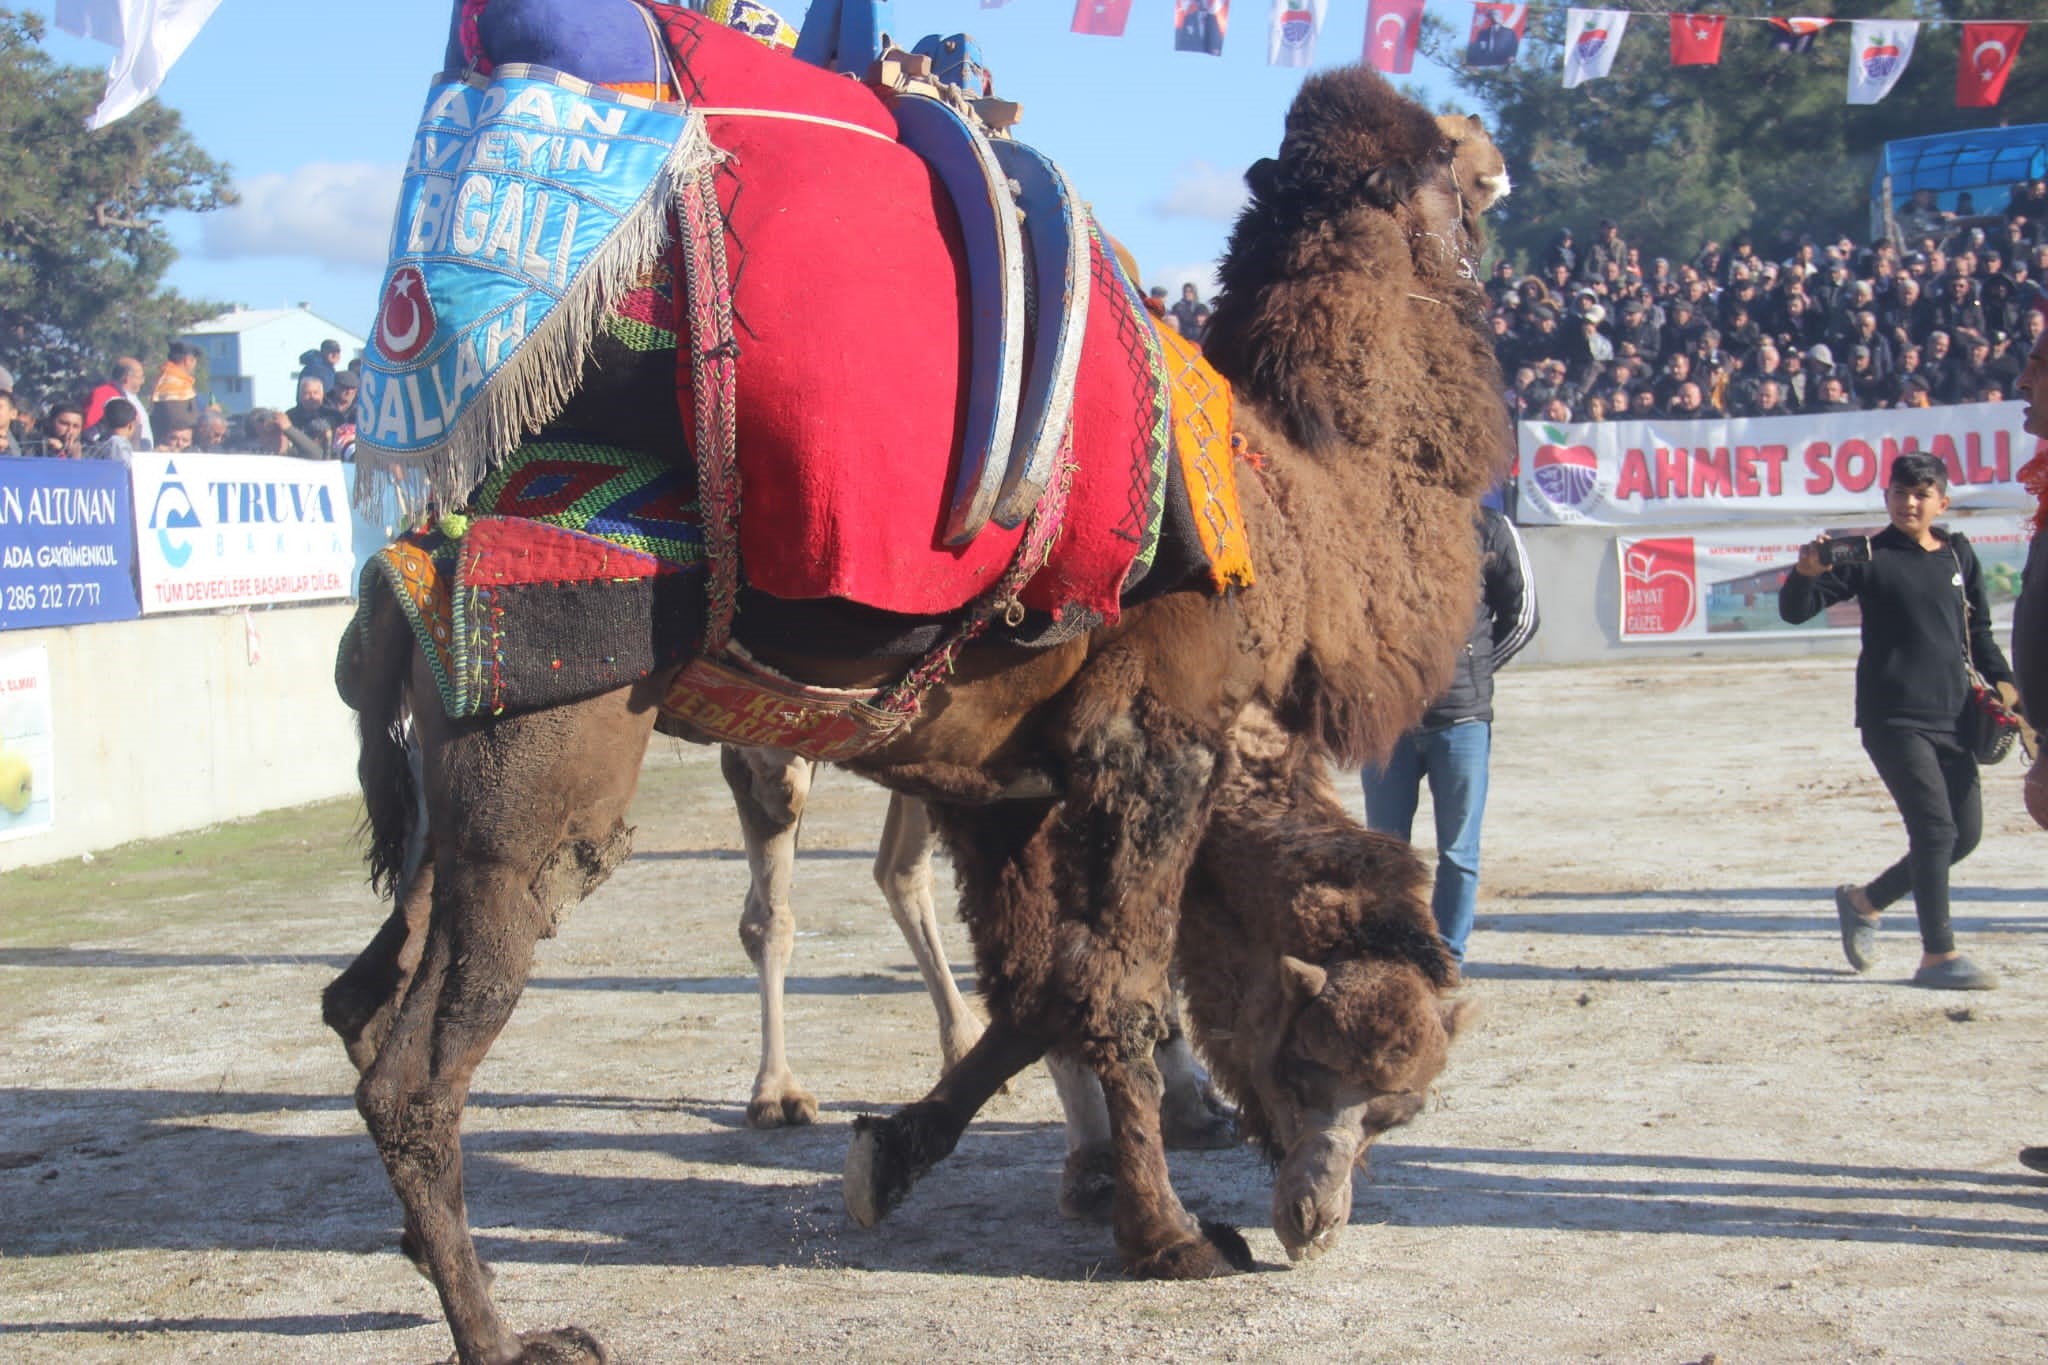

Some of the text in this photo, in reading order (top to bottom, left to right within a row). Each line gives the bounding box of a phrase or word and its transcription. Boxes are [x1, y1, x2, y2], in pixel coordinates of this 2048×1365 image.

[1615, 430, 2012, 500] AHMET SOMALI
[0, 486, 116, 526] N ALTUNAN
[208, 481, 335, 524] TRUVA
[3, 540, 118, 569] ADA GAYRİMENKUL
[6, 582, 101, 611] 286 212 7777
[155, 579, 183, 604] TÜM
[186, 576, 251, 601] DEVECİLERE
[253, 575, 309, 597] BAŞARILAR
[1627, 588, 1664, 605] HAYAT
